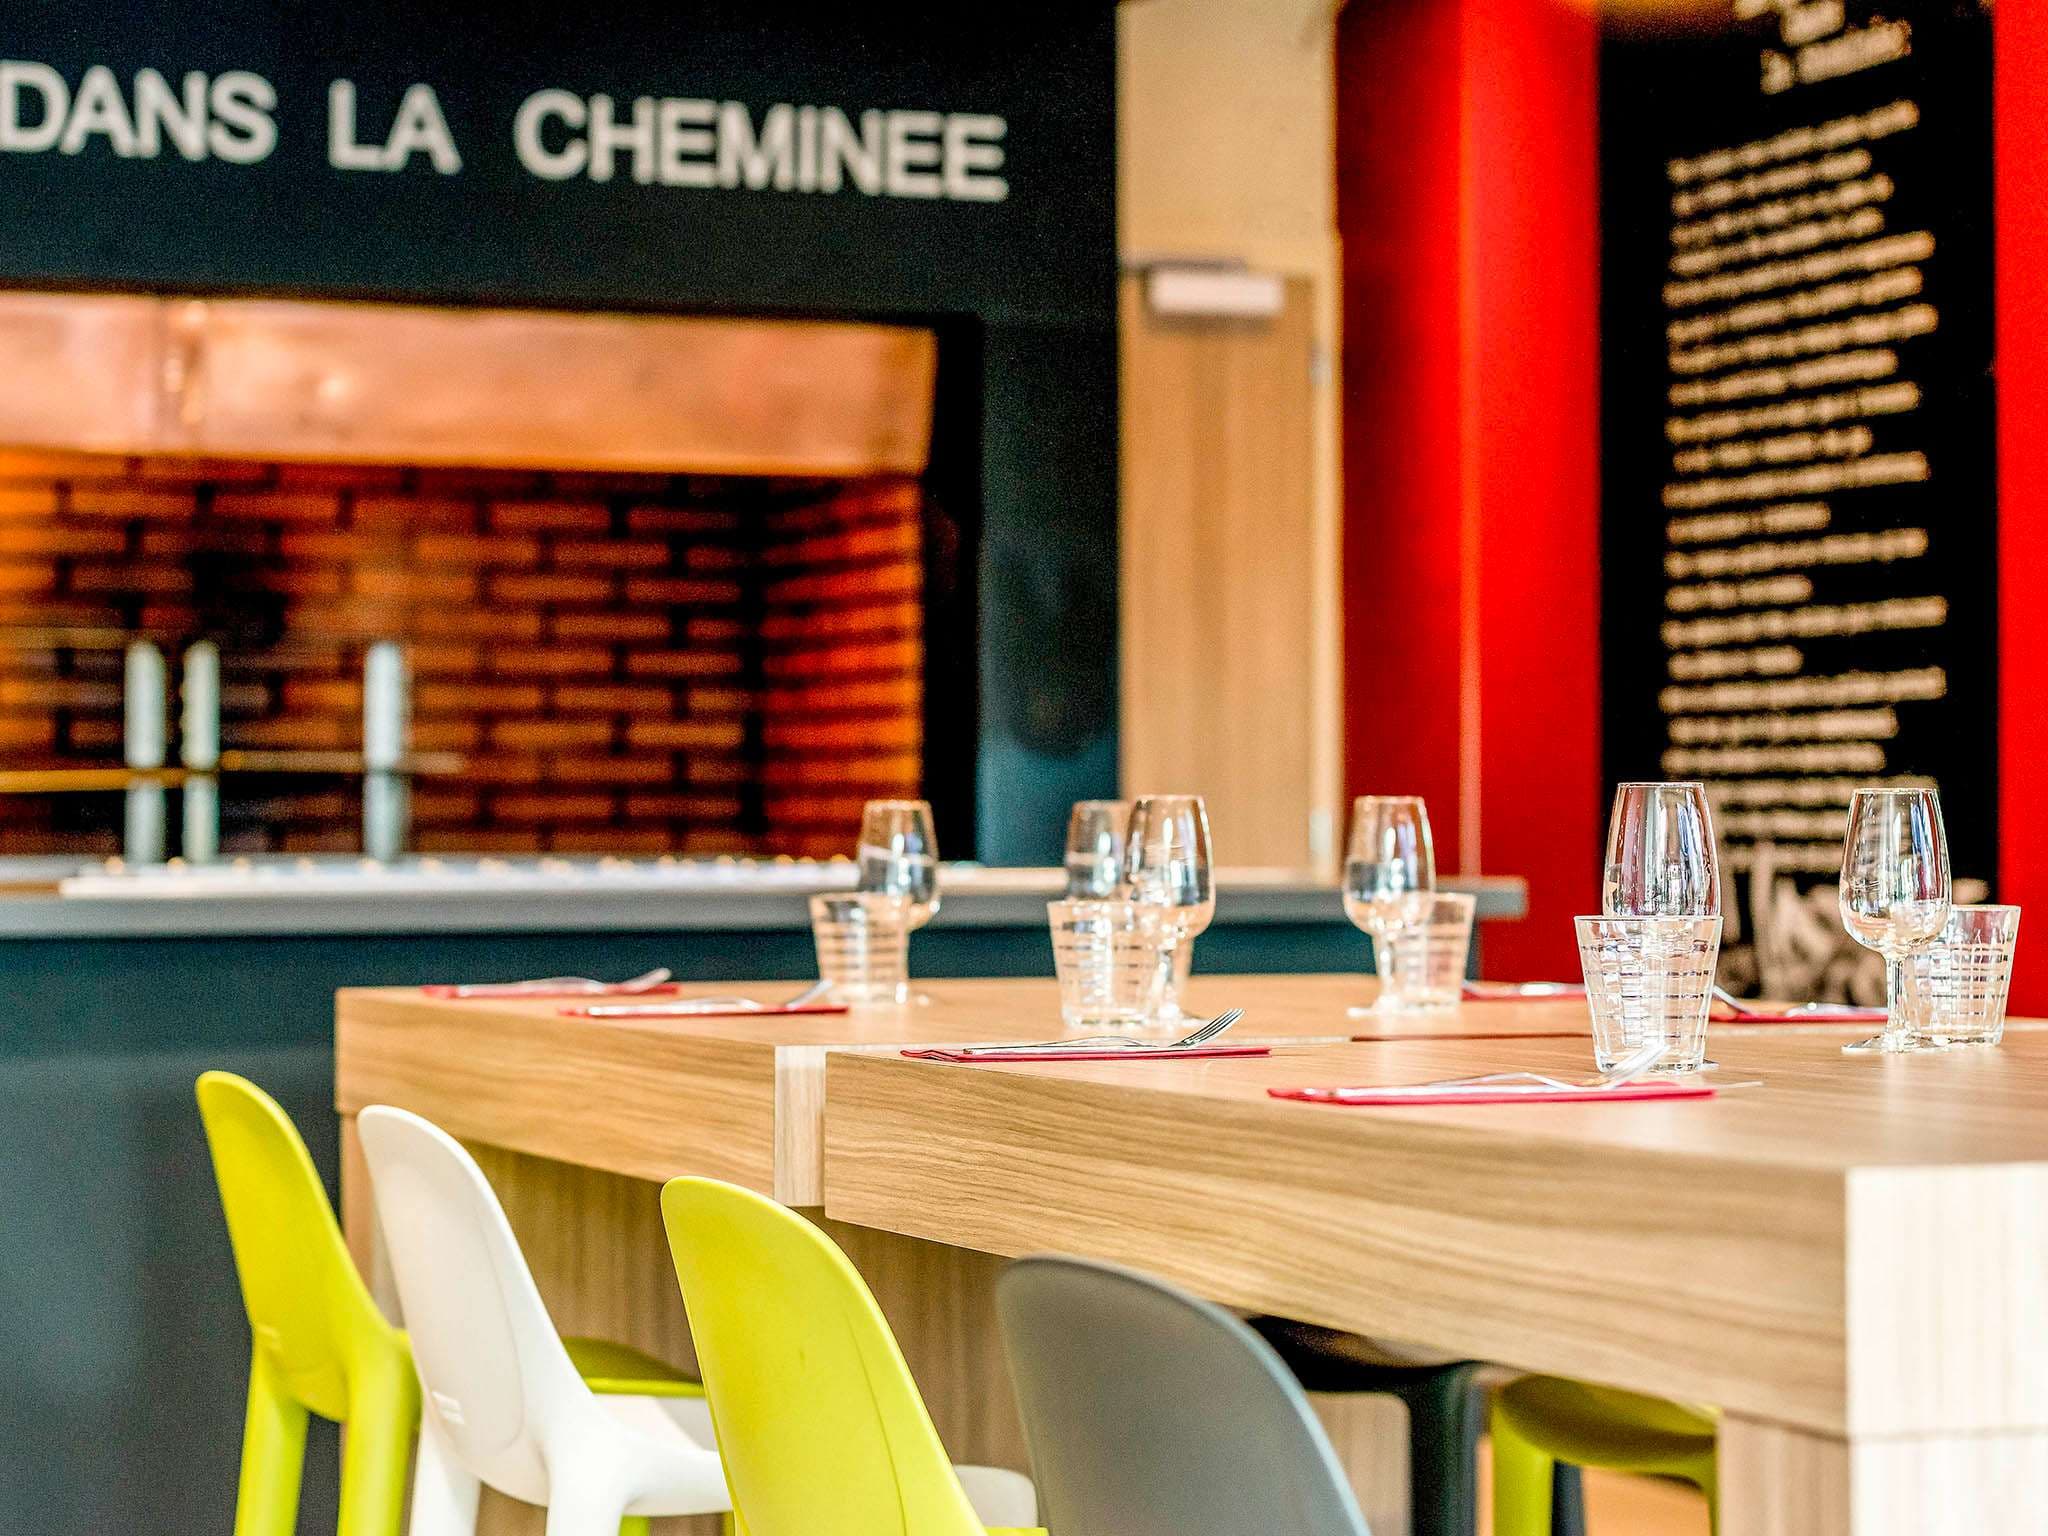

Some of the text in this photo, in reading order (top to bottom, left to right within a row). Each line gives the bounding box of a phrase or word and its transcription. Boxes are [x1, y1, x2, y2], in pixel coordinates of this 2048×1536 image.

[0, 60, 1008, 200] DANS LA CHEMINEE
